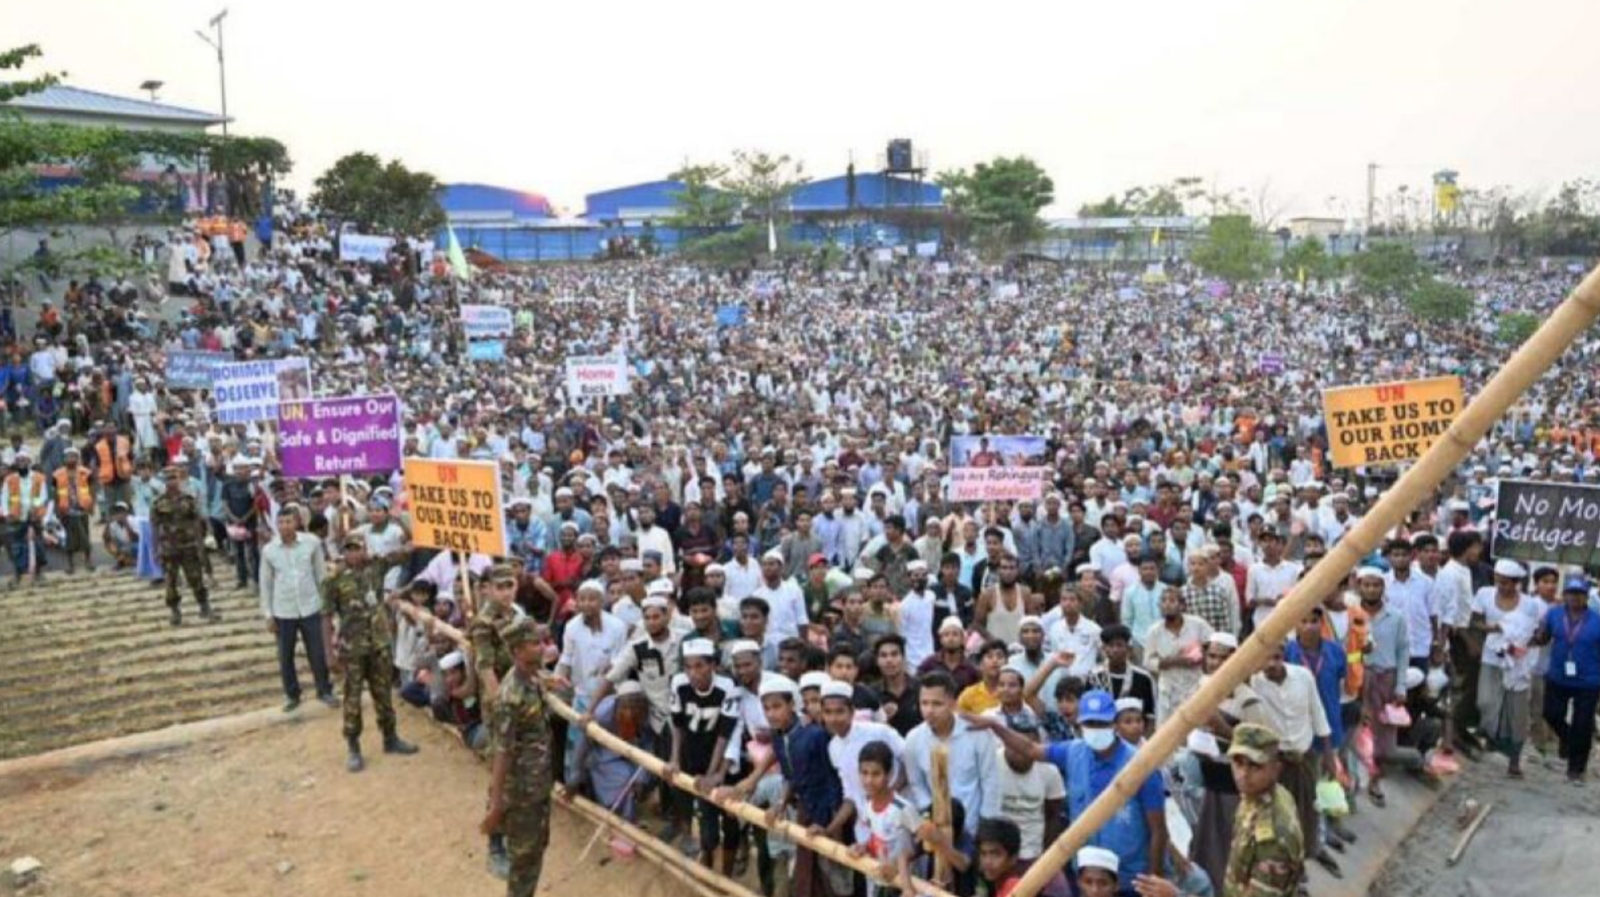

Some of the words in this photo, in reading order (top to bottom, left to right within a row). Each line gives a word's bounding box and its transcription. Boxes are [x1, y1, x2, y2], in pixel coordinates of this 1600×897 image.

[577, 367, 616, 381] Home
[216, 382, 276, 402] DESERVE
[581, 383, 606, 394] Back
[1376, 384, 1405, 403] UN
[281, 402, 308, 422] UN,
[313, 401, 362, 418] Ensure
[365, 399, 393, 415] Our
[1332, 407, 1386, 427] TAKE
[1393, 402, 1420, 420] US
[1425, 398, 1455, 416] TO
[280, 429, 312, 448] Safe
[315, 429, 327, 445] &
[331, 423, 398, 446] Dignified
[1340, 427, 1384, 446] OUR
[314, 452, 367, 471] Return!
[1364, 442, 1420, 463] BACK
[438, 465, 457, 483] UN
[988, 468, 1041, 484] Rohingya
[410, 484, 445, 504] TAKE
[449, 488, 468, 507] US
[472, 490, 494, 510] TO
[1514, 492, 1550, 515] No
[415, 505, 446, 525] OUR
[448, 509, 494, 532] HOME
[433, 528, 471, 550] BACK
[1496, 517, 1586, 551] Refugee
[685, 702, 720, 732] 77
